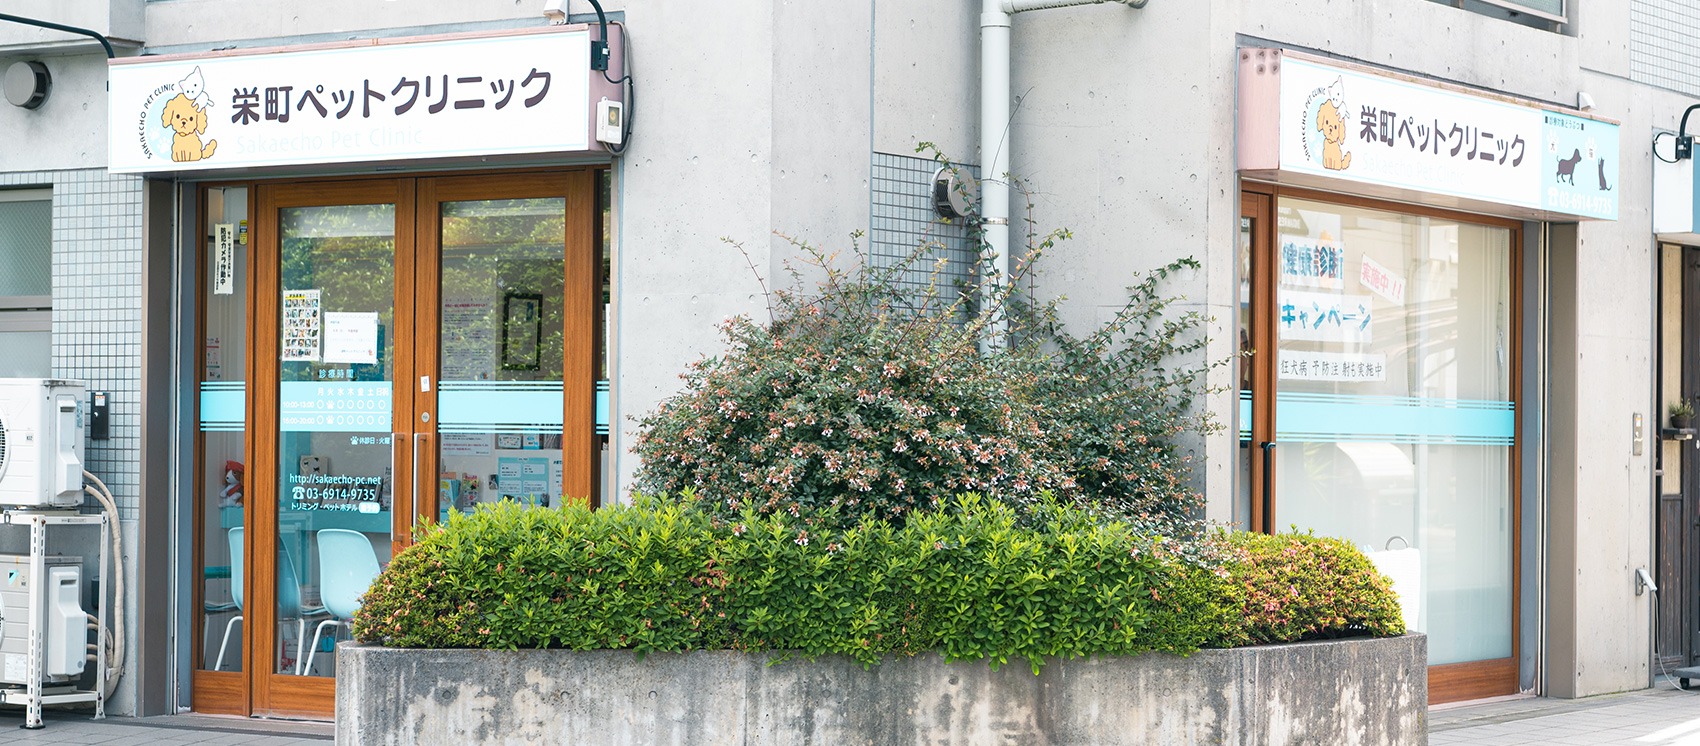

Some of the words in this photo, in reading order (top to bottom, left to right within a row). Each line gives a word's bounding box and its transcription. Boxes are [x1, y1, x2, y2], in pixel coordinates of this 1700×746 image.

[154, 83, 175, 96] CLINIC
[231, 67, 551, 125] 栄町ペットクリニック
[143, 94, 154, 109] PET
[138, 111, 153, 160] SAKAECHO
[236, 131, 323, 154] Sakaecho
[331, 130, 361, 149] Pet
[369, 126, 423, 147] Clinic
[1359, 104, 1526, 168] 栄町ペットクリニック
[1362, 152, 1412, 178] Sakaecho
[1416, 161, 1433, 181] Pet
[1437, 164, 1465, 186] Clinic
[1559, 191, 1612, 215] 03-6914-9735
[1282, 242, 1344, 280] 健康診断
[1281, 298, 1371, 332] キャンペーン
[318, 368, 354, 379] 診療時間
[317, 387, 324, 397] 月
[327, 387, 334, 397] 火
[337, 387, 345, 397] 水
[347, 387, 354, 397] 木
[357, 387, 364, 397] 金
[367, 387, 374, 397] 土
[283, 401, 314, 409] 10:00-13:00
[282, 417, 315, 425] 16:00-20:00
[289, 473, 382, 486] http://sakaecho-pc.net
[306, 487, 376, 501] 03-6914-9735
